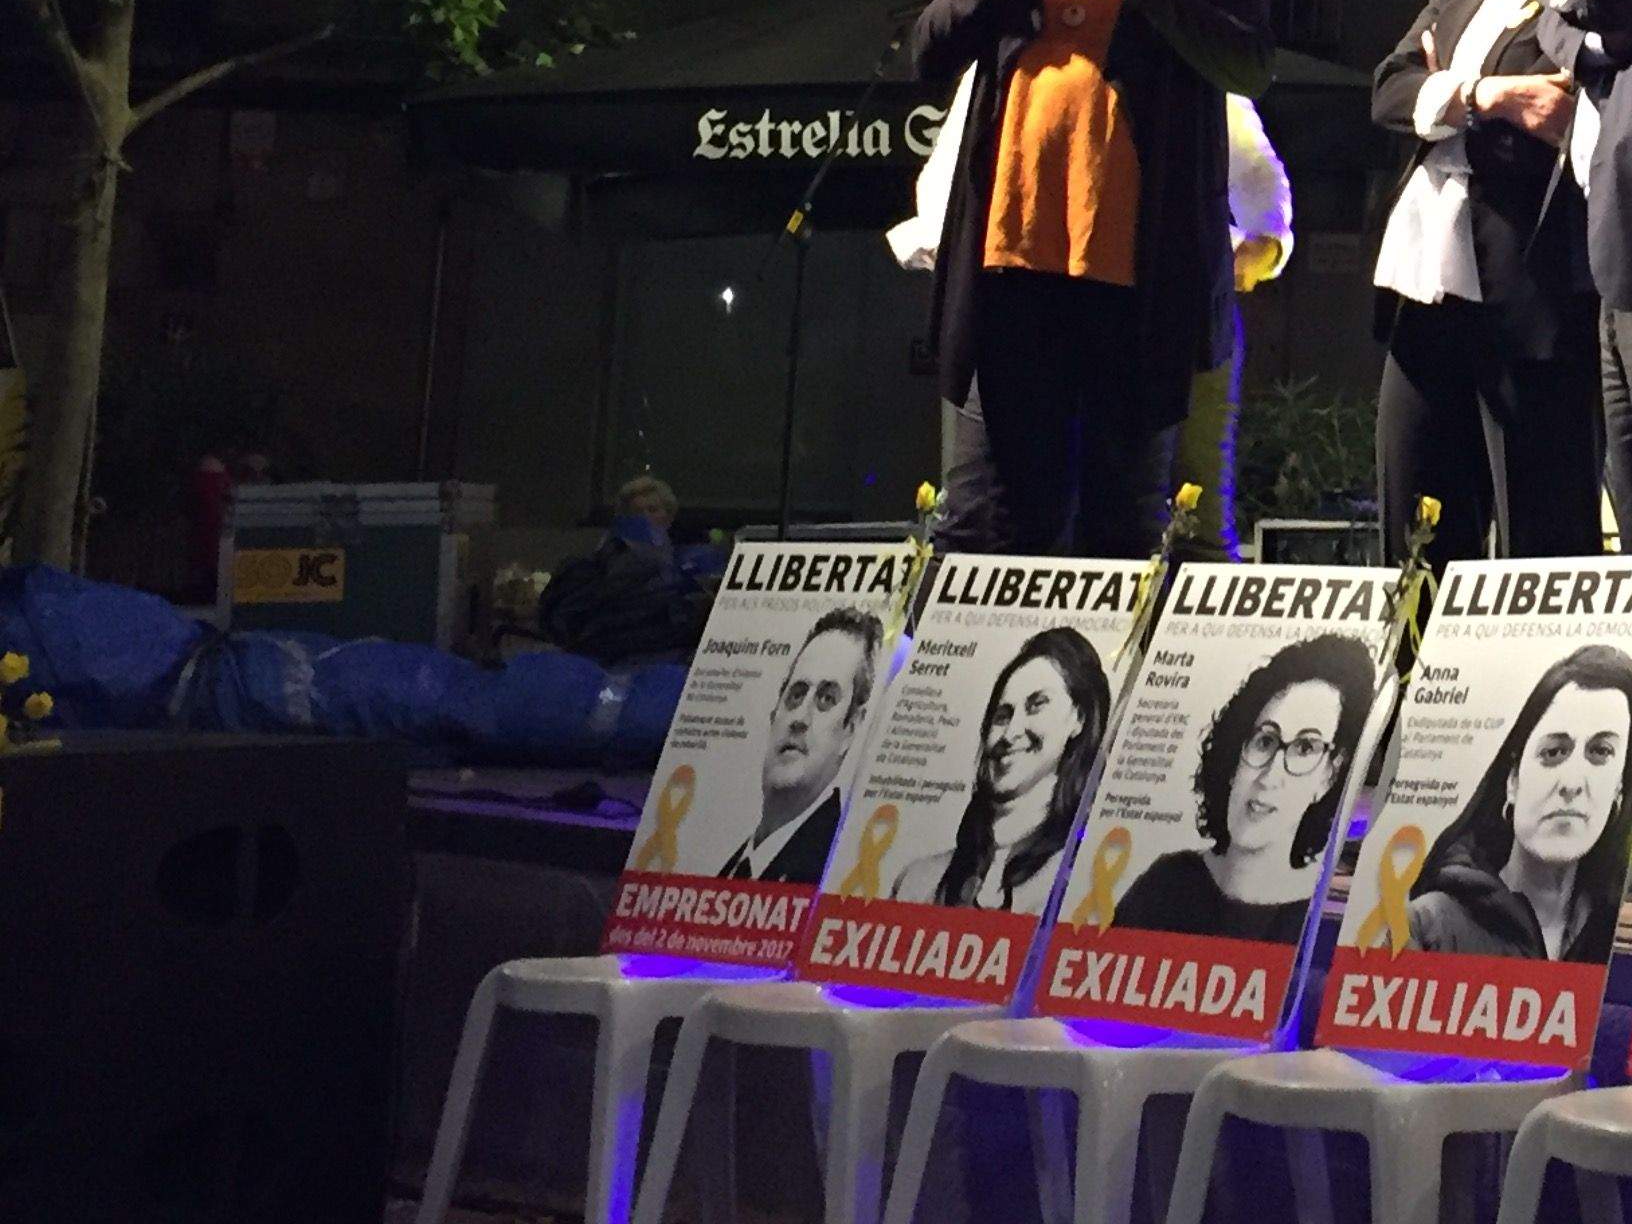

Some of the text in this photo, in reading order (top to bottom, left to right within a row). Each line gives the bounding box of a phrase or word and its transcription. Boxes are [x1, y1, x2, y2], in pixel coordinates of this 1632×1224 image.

[694, 108, 892, 159] Estrella
[725, 552, 915, 596] LLIBERTAT
[936, 565, 1143, 612] LLIBERTAT
[1435, 622, 1460, 638] PER
[1462, 623, 1472, 637] A
[1474, 622, 1499, 638] QUI
[1501, 621, 1562, 638] DEFENSA
[1564, 621, 1582, 637] LA
[701, 637, 792, 658] Joaquim Forn
[916, 638, 978, 657] Meritxell
[1152, 649, 1195, 667] Marta
[908, 659, 951, 677] Serret
[1419, 665, 1460, 681] Anna
[1144, 670, 1191, 688] Rovira
[1413, 685, 1469, 704] Gabriel
[615, 882, 810, 932] EMPRESONAT
[809, 916, 1013, 986] EXILIADA
[1048, 948, 1269, 1020] EXILIADA
[1333, 972, 1579, 1047] EXILIADA
